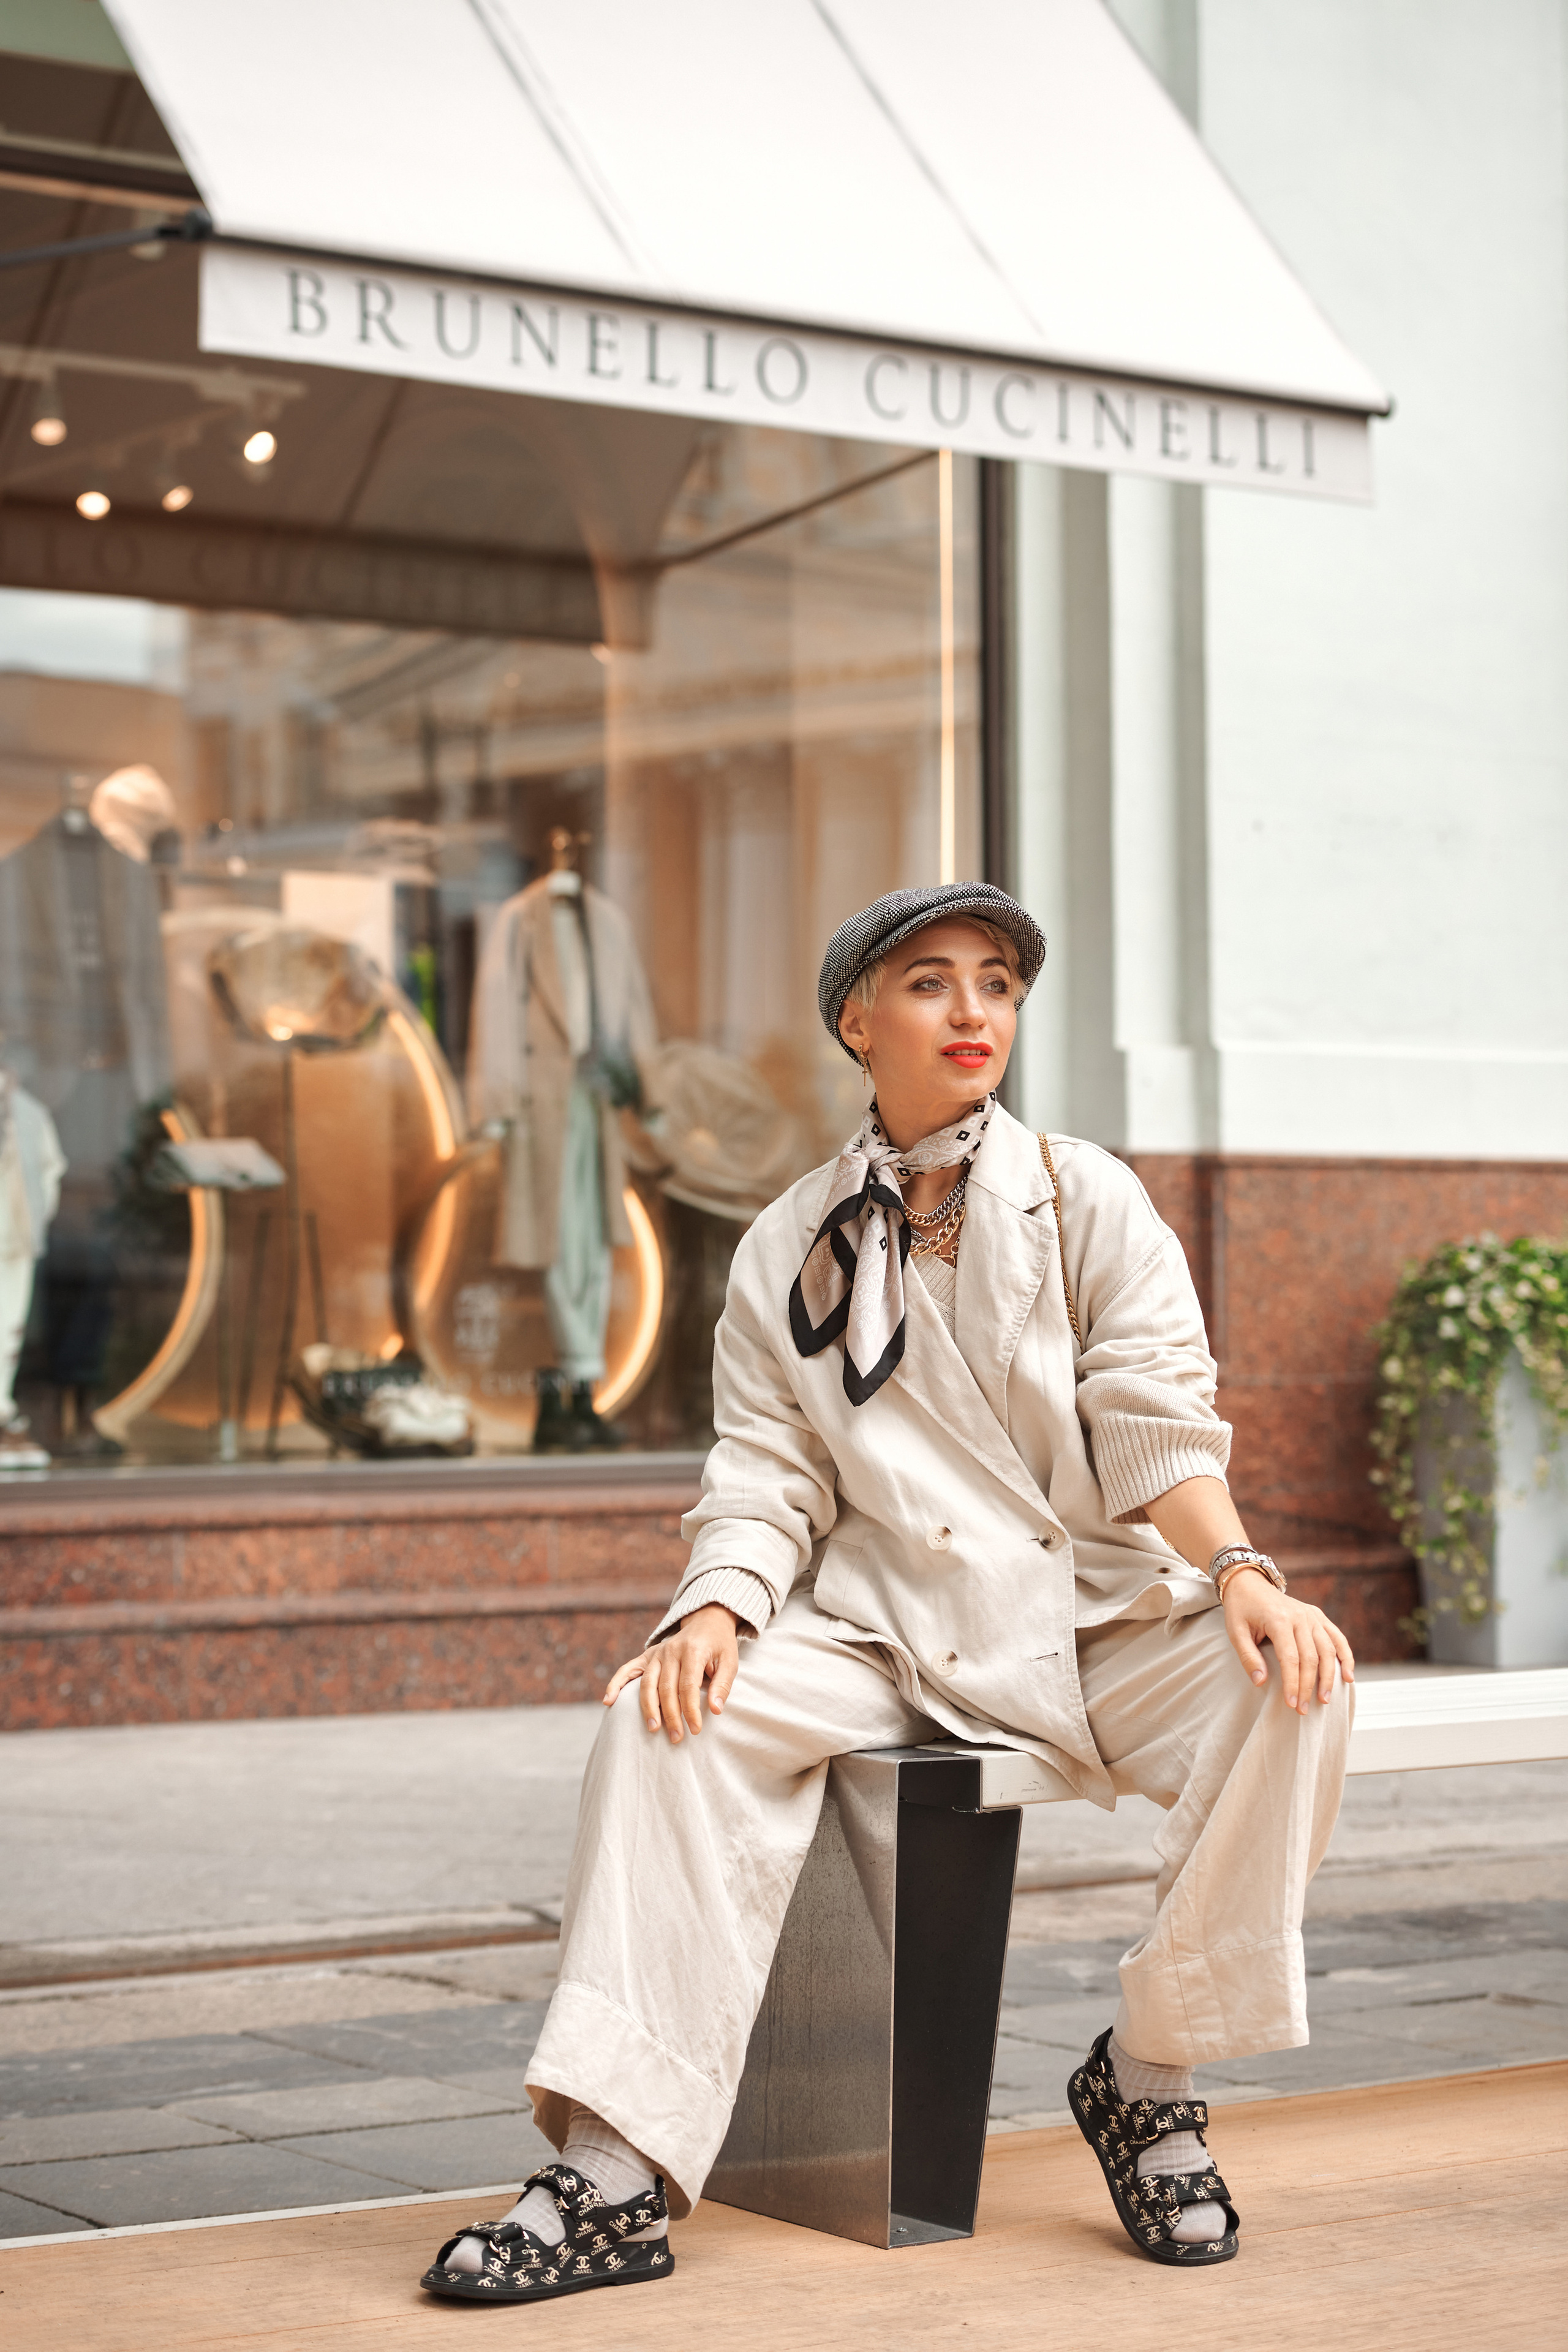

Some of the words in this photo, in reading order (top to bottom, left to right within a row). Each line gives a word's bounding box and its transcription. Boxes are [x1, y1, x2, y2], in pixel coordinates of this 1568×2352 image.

[284, 267, 809, 406] BRUNELLO
[863, 352, 1317, 478] CUCINELLI
[1078, 2098, 1089, 2119] CHANEL
[1114, 2103, 1126, 2124] CHANEL
[1117, 2151, 1131, 2163] CHANEL
[1127, 2195, 1138, 2214] CHANEL
[575, 2226, 597, 2239] CHANEL
[609, 2221, 627, 2237] CHANEL
[559, 2248, 576, 2268] CHANEL
[591, 2243, 612, 2256] CHANEL
[483, 2266, 507, 2282] CHANEL
